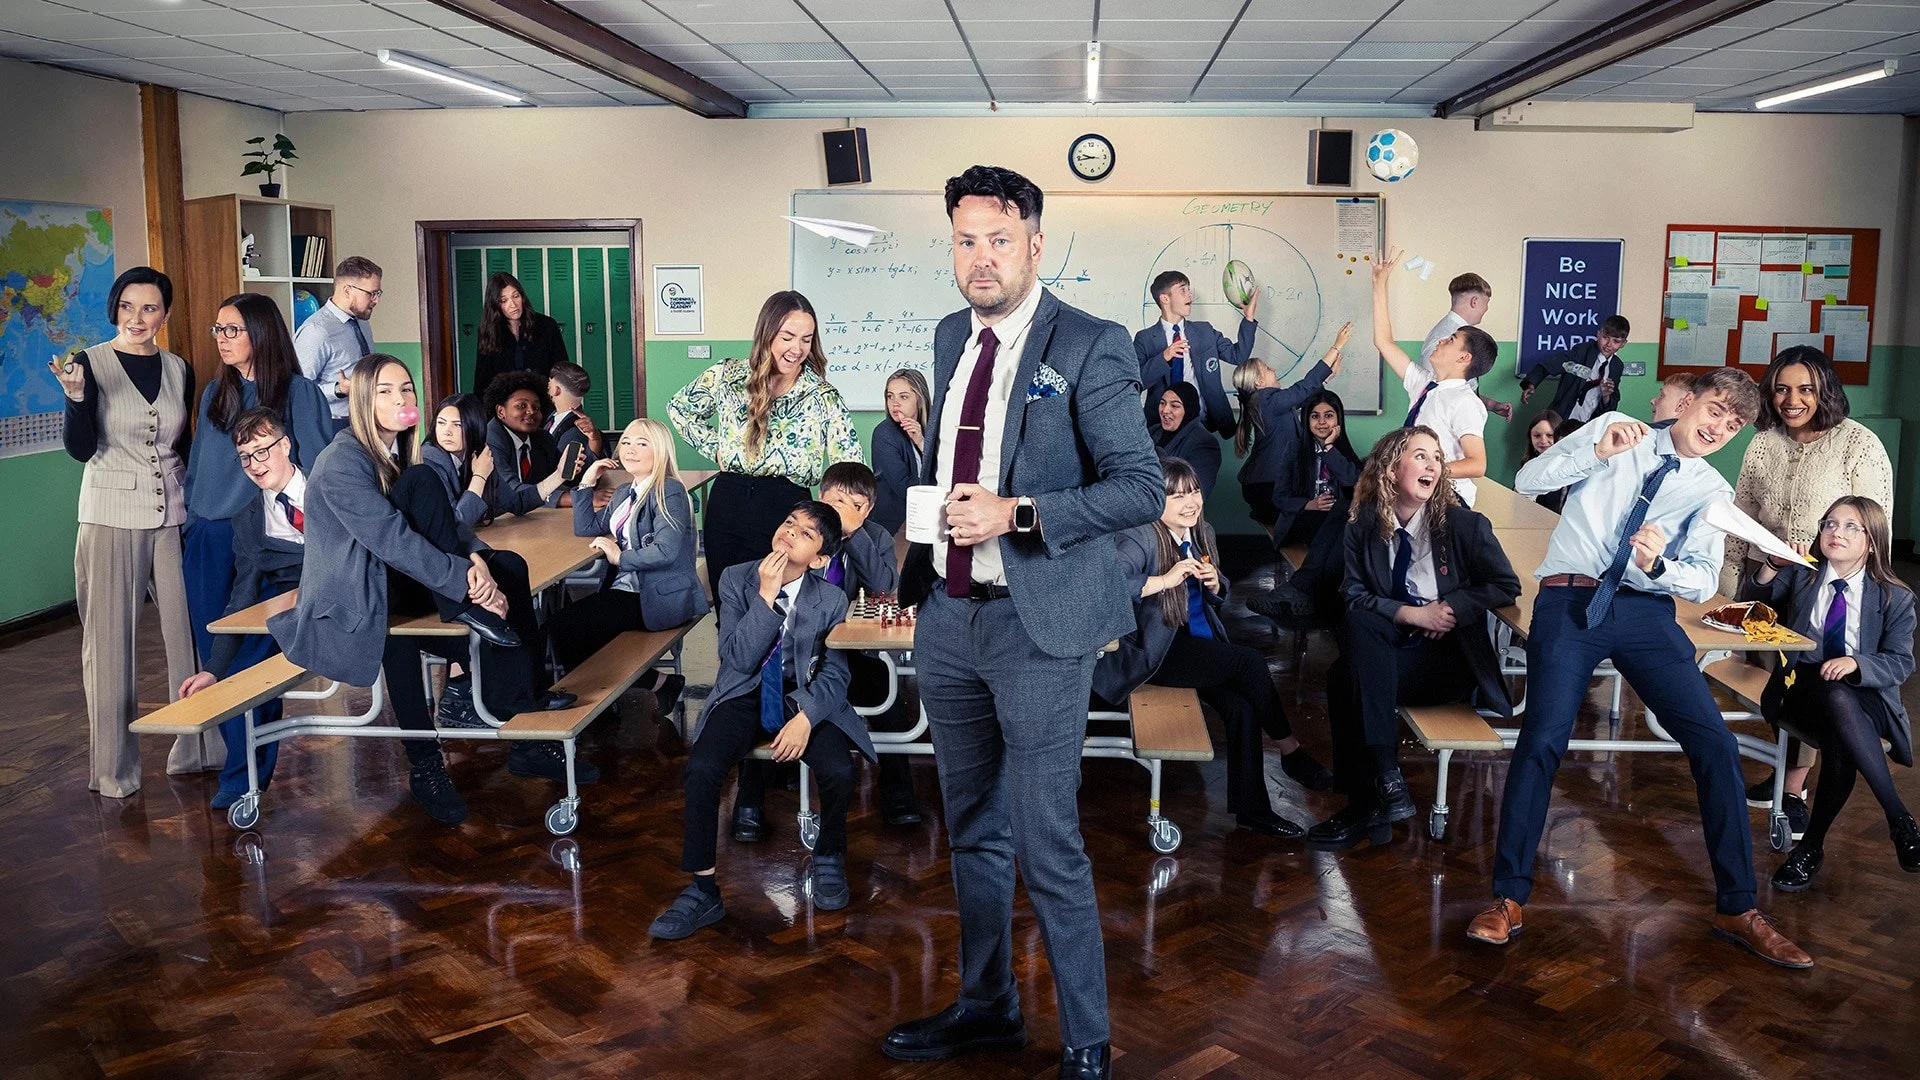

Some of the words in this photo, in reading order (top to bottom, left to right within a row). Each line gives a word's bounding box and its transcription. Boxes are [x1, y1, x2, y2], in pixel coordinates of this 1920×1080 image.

[1182, 197, 1274, 216] GEOMETRY
[1559, 256, 1586, 273] Be
[1545, 282, 1598, 300] NICE
[1541, 308, 1599, 326] Work
